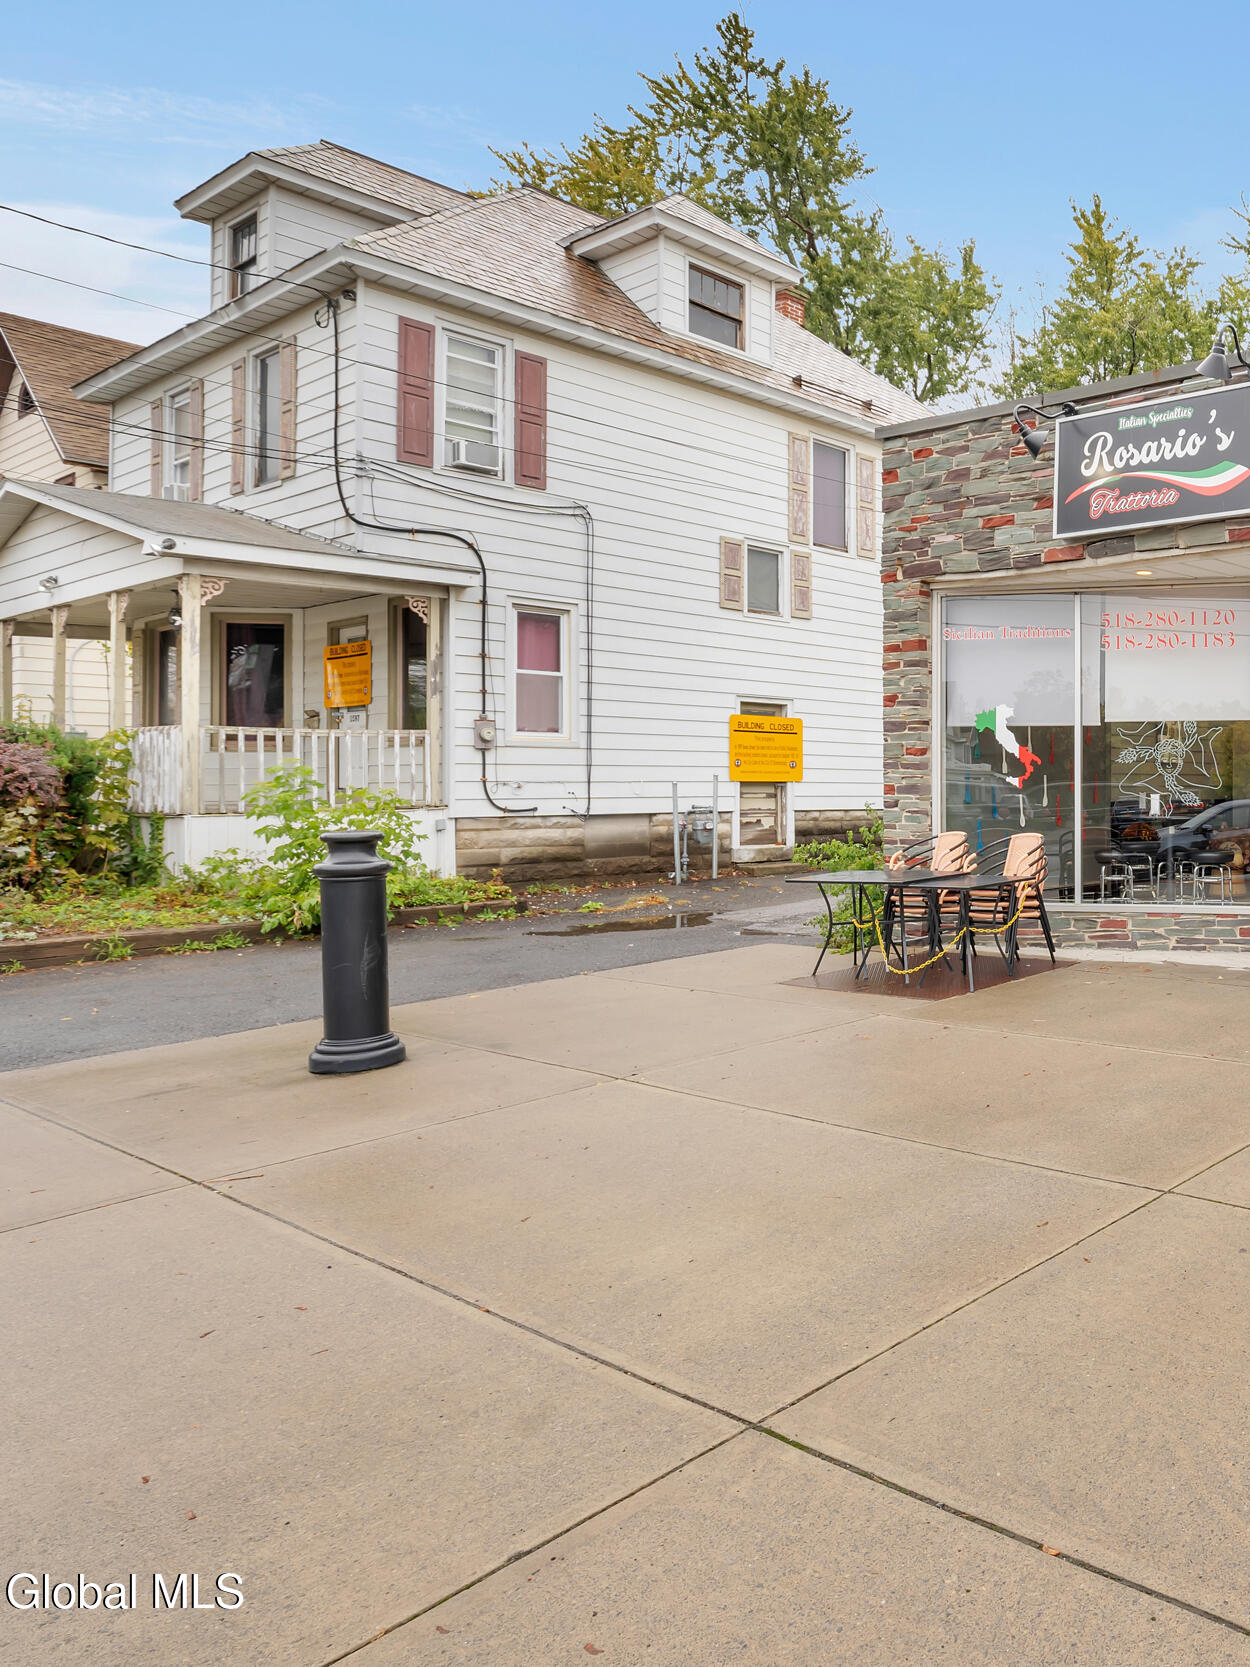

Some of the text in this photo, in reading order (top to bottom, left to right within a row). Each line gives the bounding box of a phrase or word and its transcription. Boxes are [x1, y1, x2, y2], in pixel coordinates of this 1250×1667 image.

[1118, 406, 1193, 430] Italian Specialties
[1081, 409, 1235, 477] Rosario's
[1090, 488, 1180, 520] Trattoria
[1101, 609, 1236, 629] 518-280-1120
[943, 624, 1073, 641] Sicilian Traditions
[1101, 631, 1236, 650] 518-280-1183
[737, 721, 795, 732] BUILDING CLOSED
